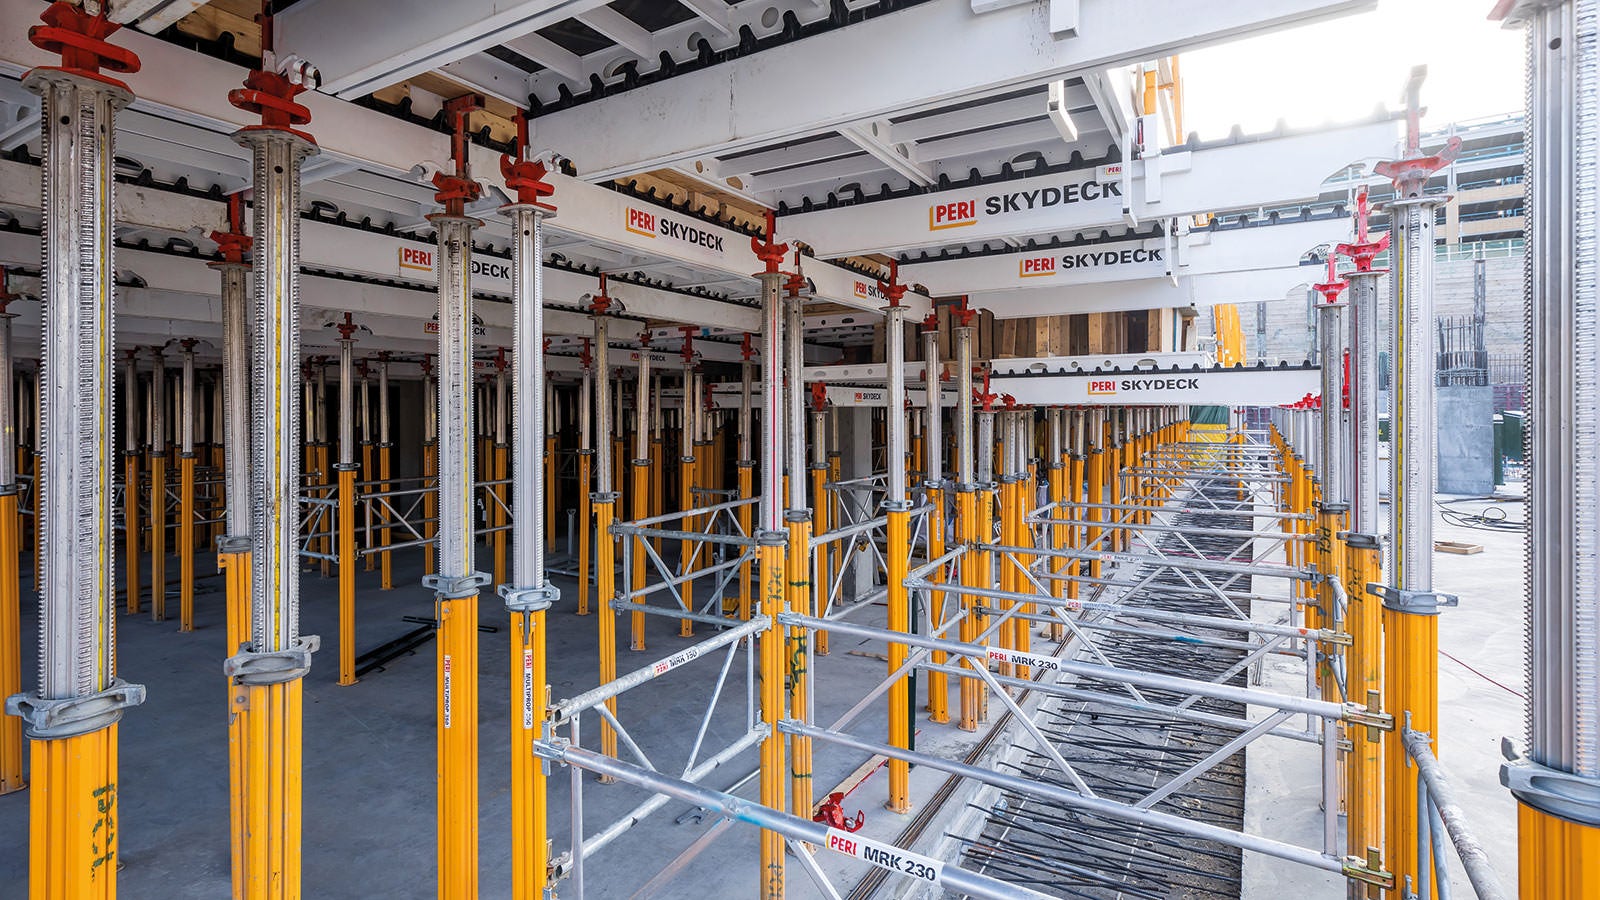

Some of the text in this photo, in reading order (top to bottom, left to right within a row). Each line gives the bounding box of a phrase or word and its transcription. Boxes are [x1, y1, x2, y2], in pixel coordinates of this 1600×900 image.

[935, 181, 1122, 223] PERI SKYDECK
[630, 208, 724, 252] PERI SKYDECK
[403, 248, 510, 280] PERI DECK
[1024, 249, 1163, 273] PERI SKYDECK
[855, 281, 867, 294] PERI
[862, 392, 882, 401] SKYDECK
[1091, 379, 1199, 391] PERI SKYDECK
[1319, 525, 1331, 555] PCL
[523, 654, 533, 669] PERI
[989, 651, 1058, 671] PERI MRK 230
[524, 673, 533, 712] MULTIPROP
[830, 835, 936, 882] PERI MRK 230
